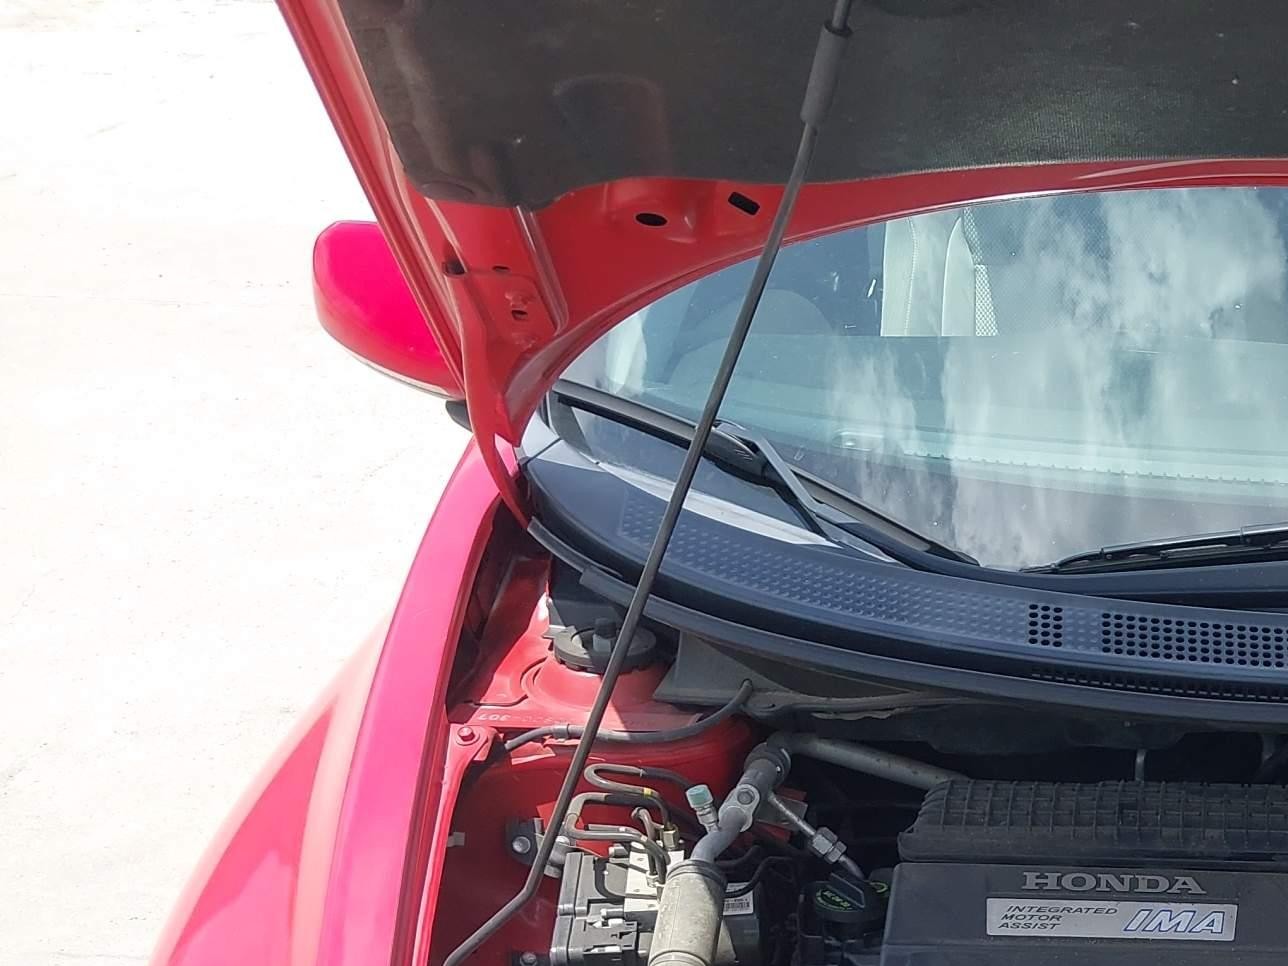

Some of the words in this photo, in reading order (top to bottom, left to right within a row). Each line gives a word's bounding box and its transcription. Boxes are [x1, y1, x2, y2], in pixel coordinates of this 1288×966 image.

[1021, 871, 1207, 895] HONDA
[1007, 905, 1118, 915] INTEGRATED
[1000, 913, 1063, 922] MOTOR
[1124, 909, 1226, 934] IMA
[998, 922, 1061, 931] ASSIST
